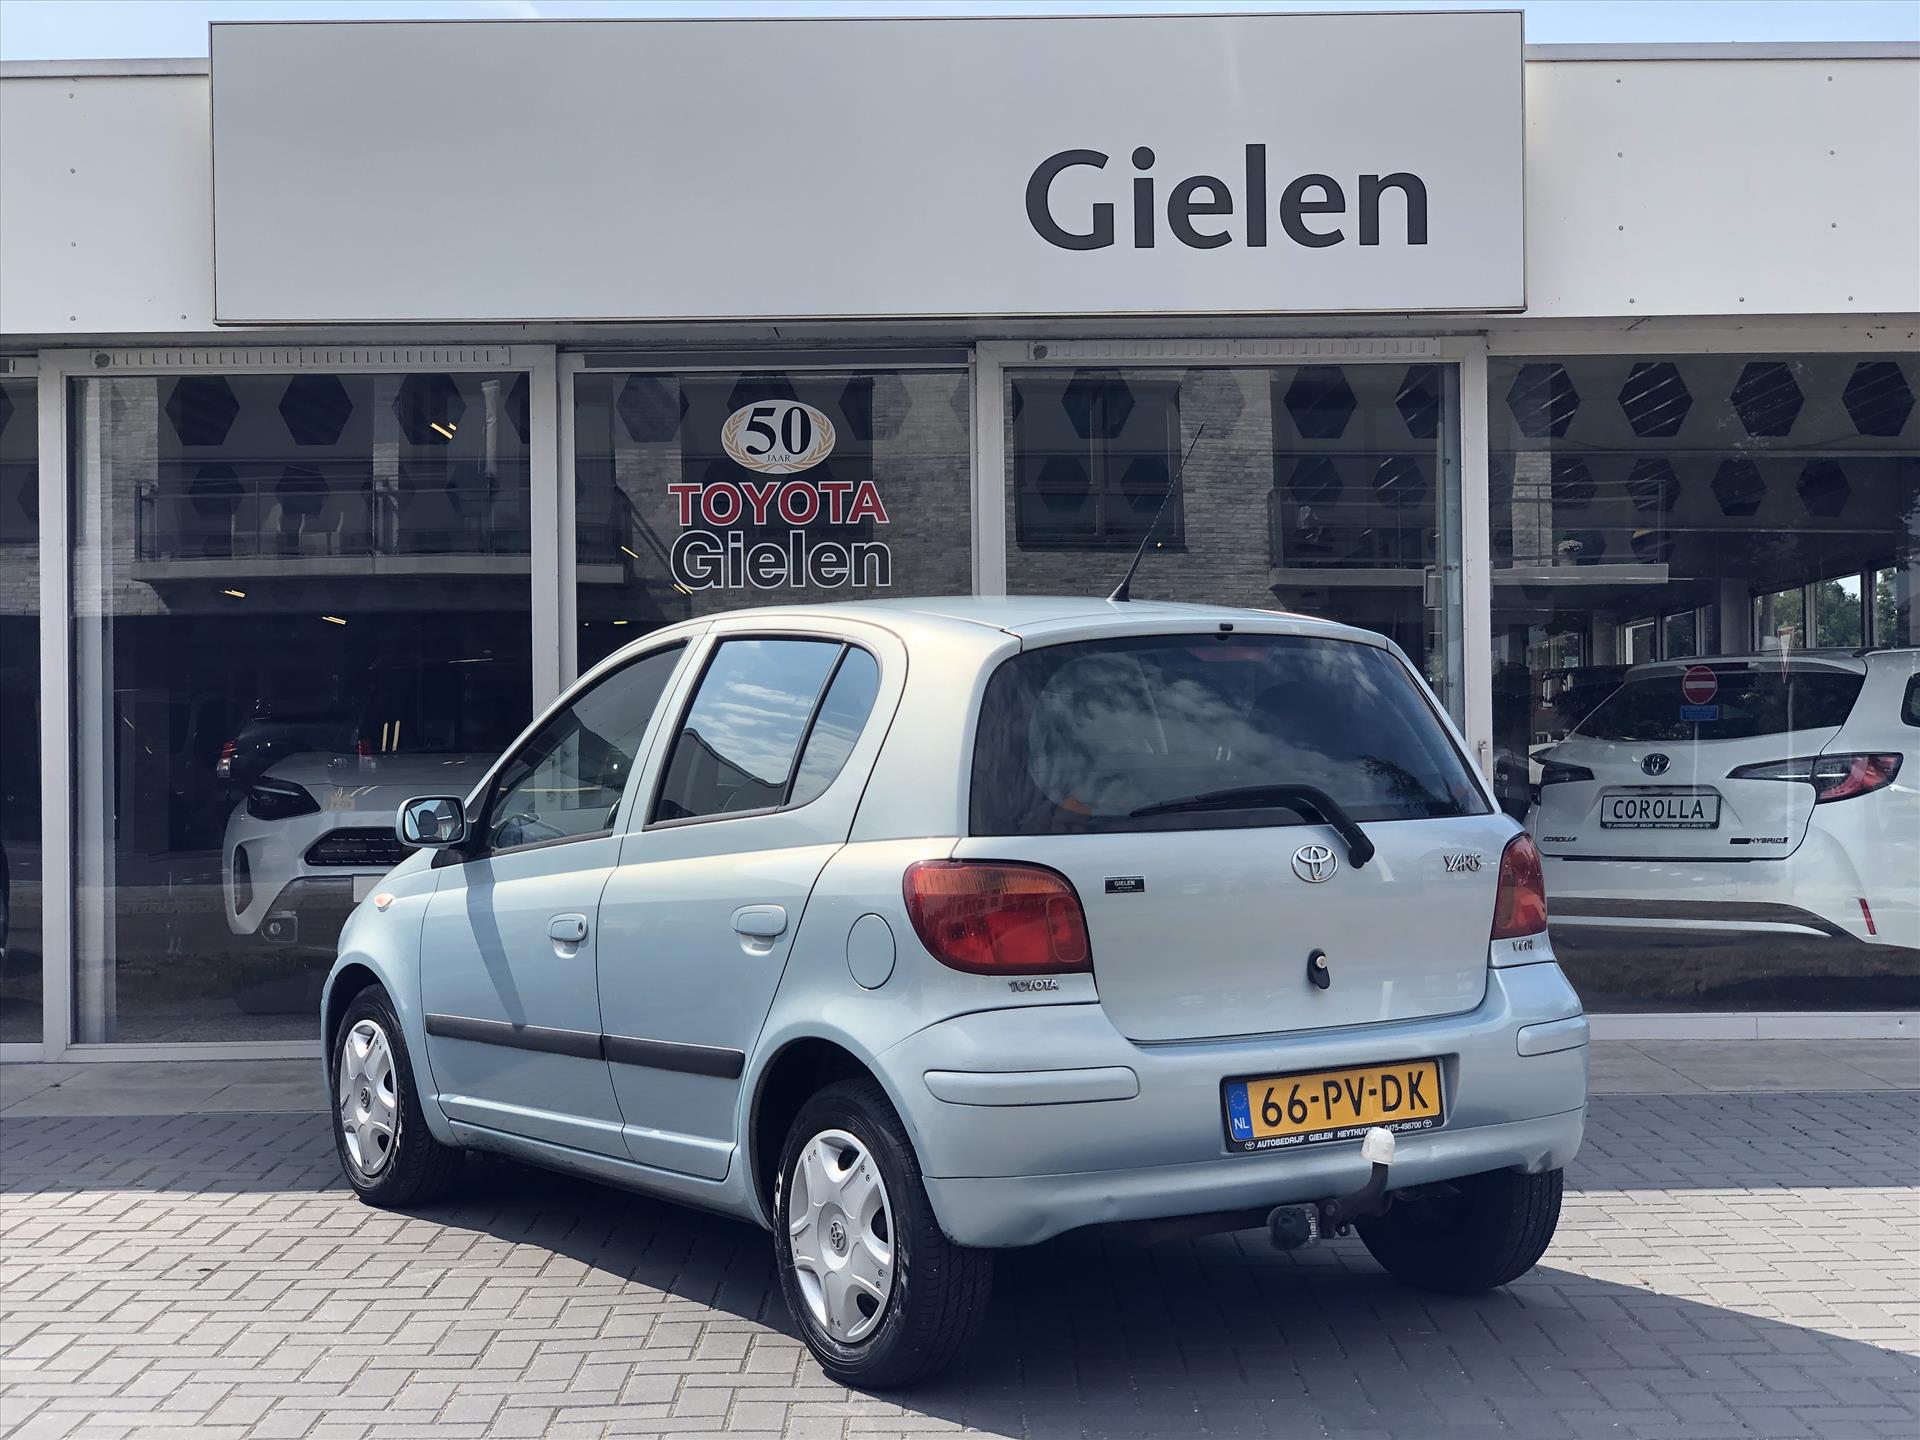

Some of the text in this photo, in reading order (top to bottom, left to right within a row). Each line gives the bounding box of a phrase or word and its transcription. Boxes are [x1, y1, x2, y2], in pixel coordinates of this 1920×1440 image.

[1025, 143, 1428, 251] Gielen
[745, 406, 811, 455] 50
[766, 454, 791, 462] JAAR
[667, 480, 889, 526] TOYOTA
[670, 529, 891, 590] Gielen
[1613, 799, 1704, 819] COROLLA
[1443, 853, 1481, 872] YARIS
[1008, 979, 1060, 992] TOYOTA
[1261, 1070, 1429, 1128] 66-PV-DK
[1234, 1117, 1250, 1130] NL
[1256, 1121, 1422, 1149] AUTOBEDRIJF GIELEN HEYTHUYS 0475-498700
